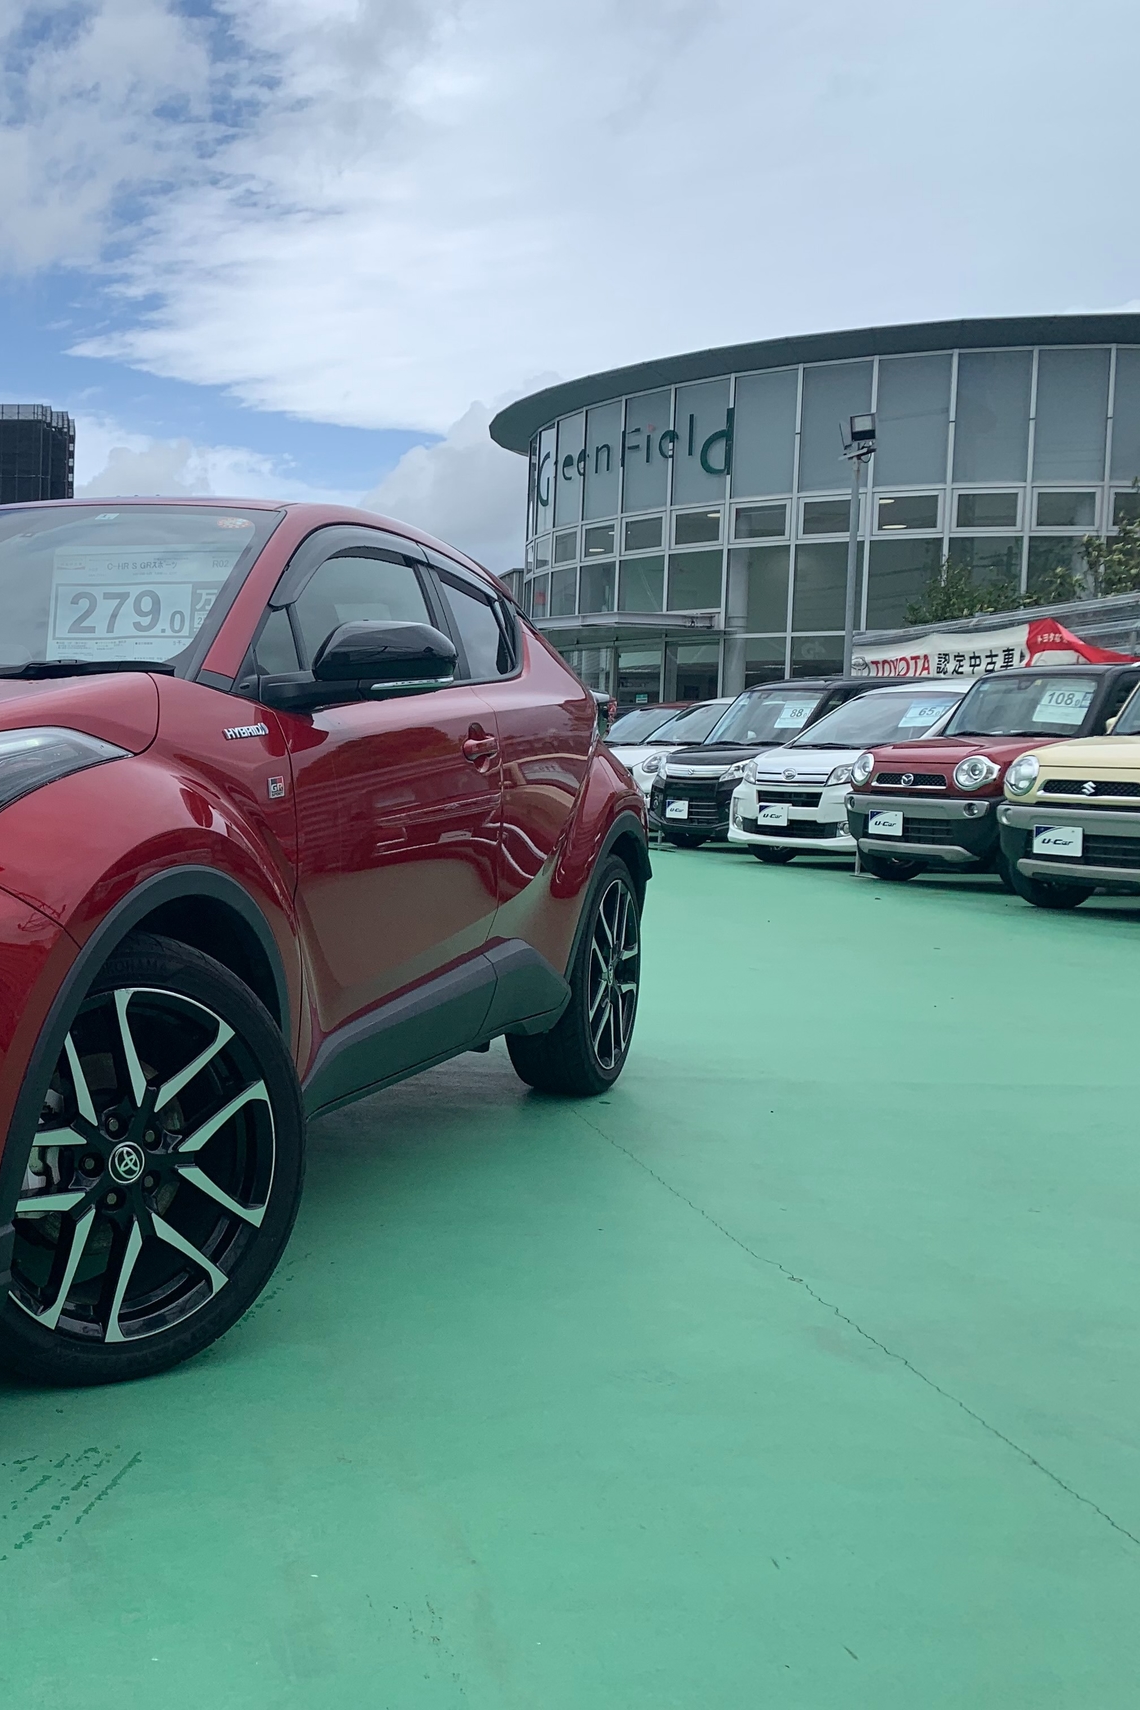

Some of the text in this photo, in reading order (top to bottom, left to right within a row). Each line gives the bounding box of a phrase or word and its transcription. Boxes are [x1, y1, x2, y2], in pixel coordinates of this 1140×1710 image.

[67, 589, 186, 634] 279.0
[870, 647, 1016, 677] TOYOTA 認定中古車
[222, 722, 269, 740] HYBRID
[271, 783, 283, 792] GR
[1041, 837, 1074, 847] U-Car
